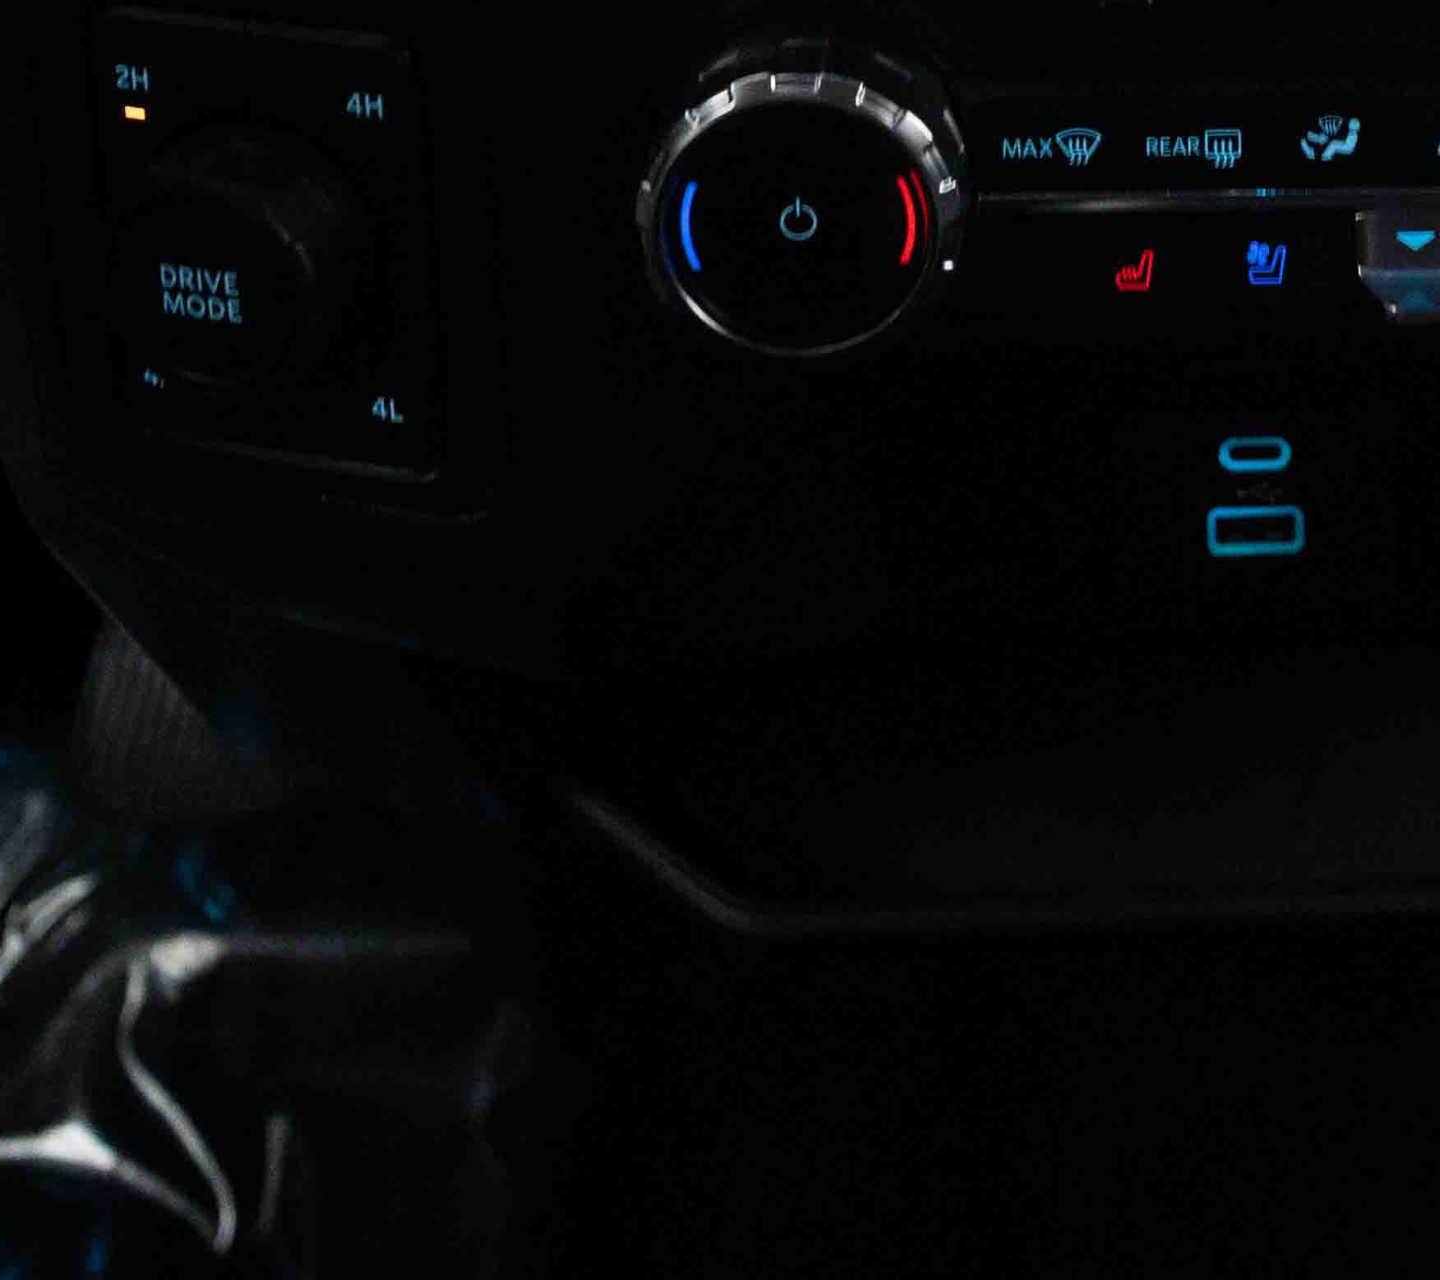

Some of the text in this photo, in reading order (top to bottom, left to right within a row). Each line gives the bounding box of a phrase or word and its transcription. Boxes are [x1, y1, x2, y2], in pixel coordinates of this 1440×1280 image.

[115, 62, 150, 92] 2H
[346, 92, 385, 121] 4H
[1002, 136, 1053, 160] MAX
[1146, 135, 1201, 159] REAR
[160, 263, 239, 296] DRIVE
[163, 292, 242, 324] MODE
[372, 396, 404, 423] 4L
